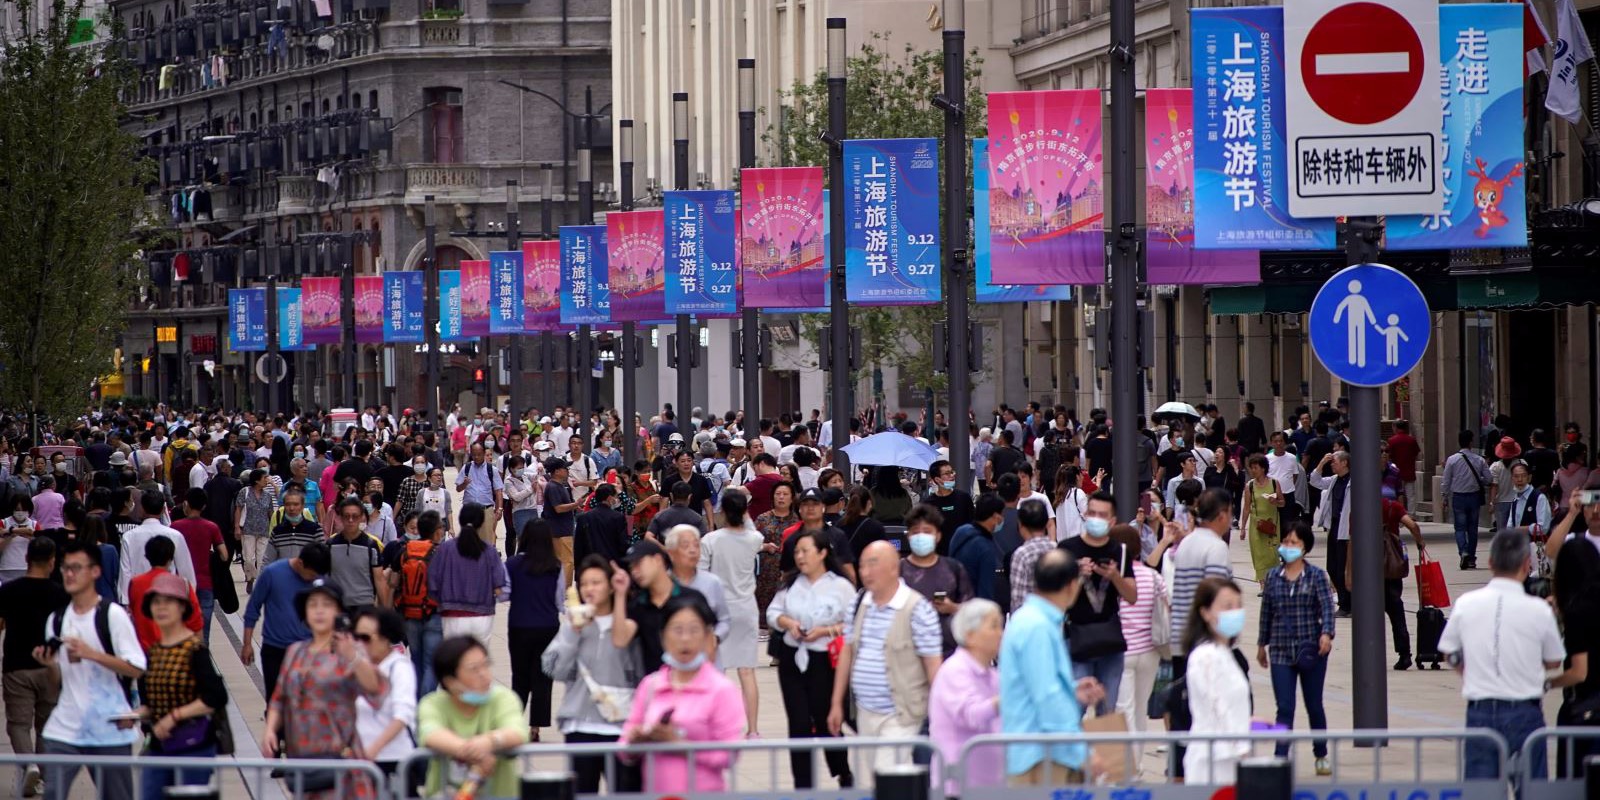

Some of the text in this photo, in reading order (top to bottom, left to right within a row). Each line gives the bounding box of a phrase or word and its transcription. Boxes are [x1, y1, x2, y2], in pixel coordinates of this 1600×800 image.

[1456, 27, 1489, 94] 走进
[1558, 66, 1572, 86] Jin
[1206, 34, 1218, 141] 二零二零年第三十一届
[1012, 129, 1080, 145] 2020.9.12
[1222, 32, 1258, 211] 上海旅游节
[1260, 32, 1273, 211] SHANGHAI TOURISM FESTIVAL
[1303, 146, 1427, 186] 除特种车辆外
[864, 156, 888, 277] 上海旅游节
[889, 156, 899, 275] SHANGHAI TOURISM FESTIVAL
[907, 233, 935, 245] 9.12
[1216, 228, 1314, 240] 上海旅游节组织委员会
[571, 236, 587, 309] 上海旅游节
[679, 203, 697, 294] 上海旅游节
[712, 262, 732, 271] 9.12
[908, 264, 936, 276] 9.27
[391, 278, 402, 331] 上海旅游节
[449, 286, 459, 336] 美好与欢乐
[499, 260, 512, 321] 上海旅游节
[712, 285, 732, 294] 9.27
